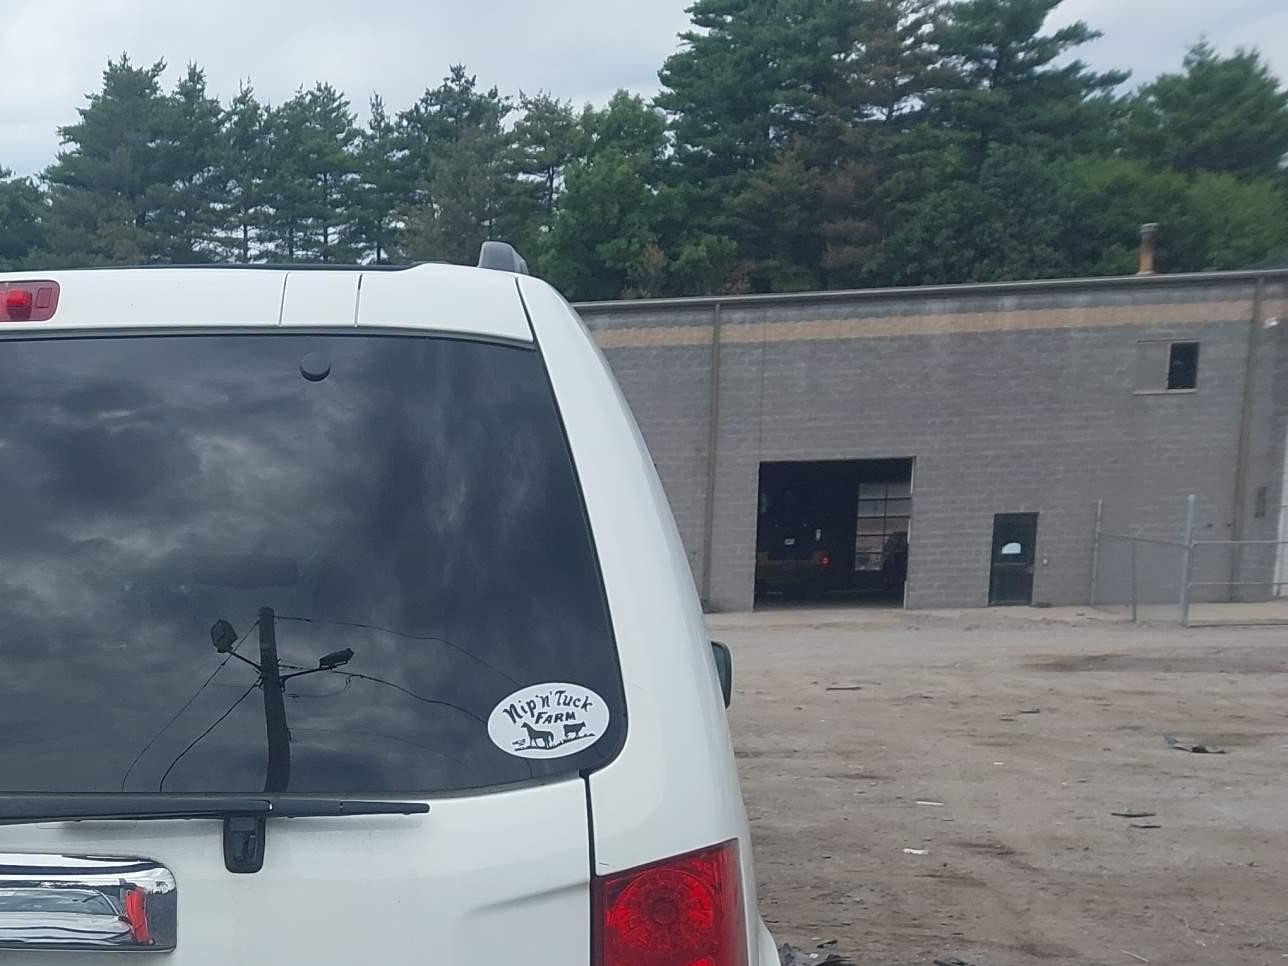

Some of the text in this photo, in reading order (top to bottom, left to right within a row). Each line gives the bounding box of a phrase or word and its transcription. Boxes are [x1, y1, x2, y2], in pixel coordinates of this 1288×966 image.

[502, 698, 537, 725] Nip
[554, 690, 593, 712] Tuck
[534, 711, 577, 725] FARM
